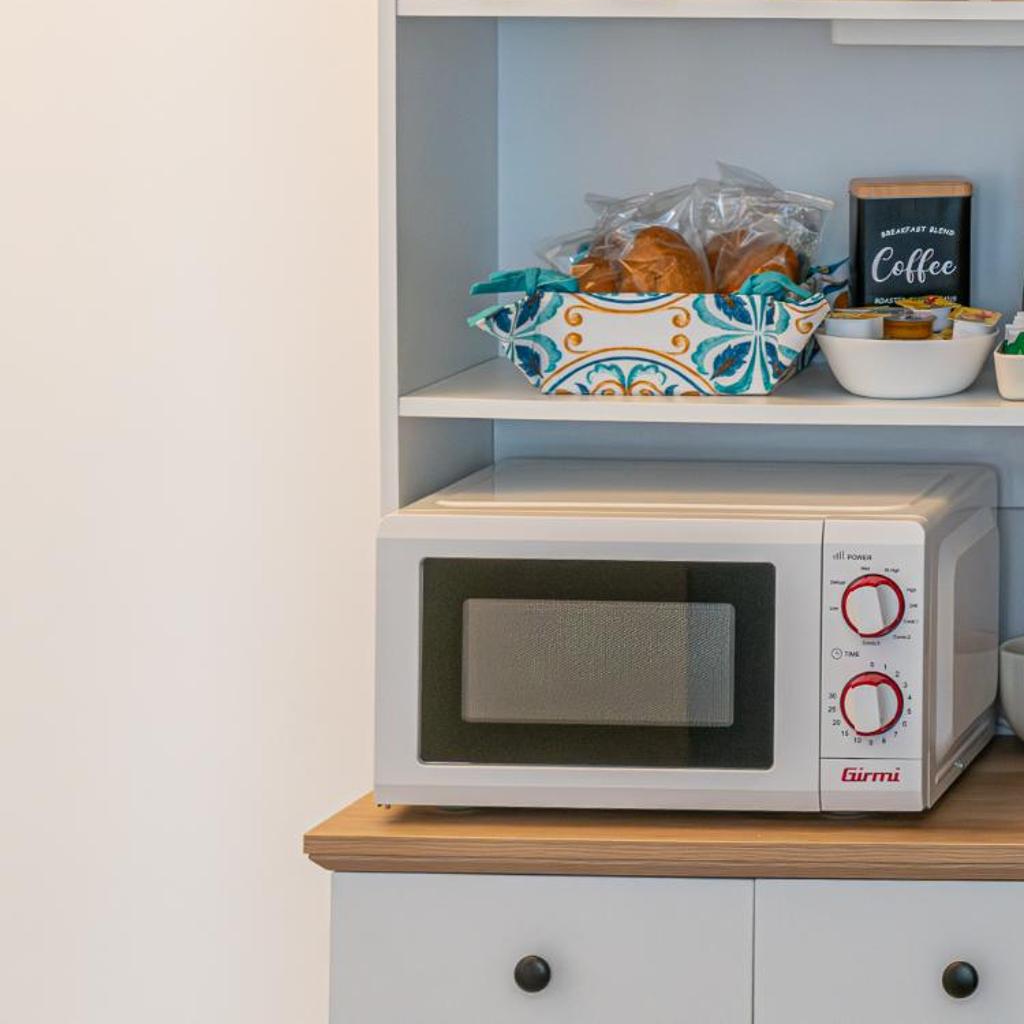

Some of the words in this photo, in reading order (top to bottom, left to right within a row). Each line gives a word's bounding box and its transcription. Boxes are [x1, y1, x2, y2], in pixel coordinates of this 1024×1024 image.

[881, 226, 926, 238] BREAKFAST
[929, 226, 956, 236] BLEND
[871, 246, 957, 284] Coffee
[841, 767, 901, 782] Girmi
